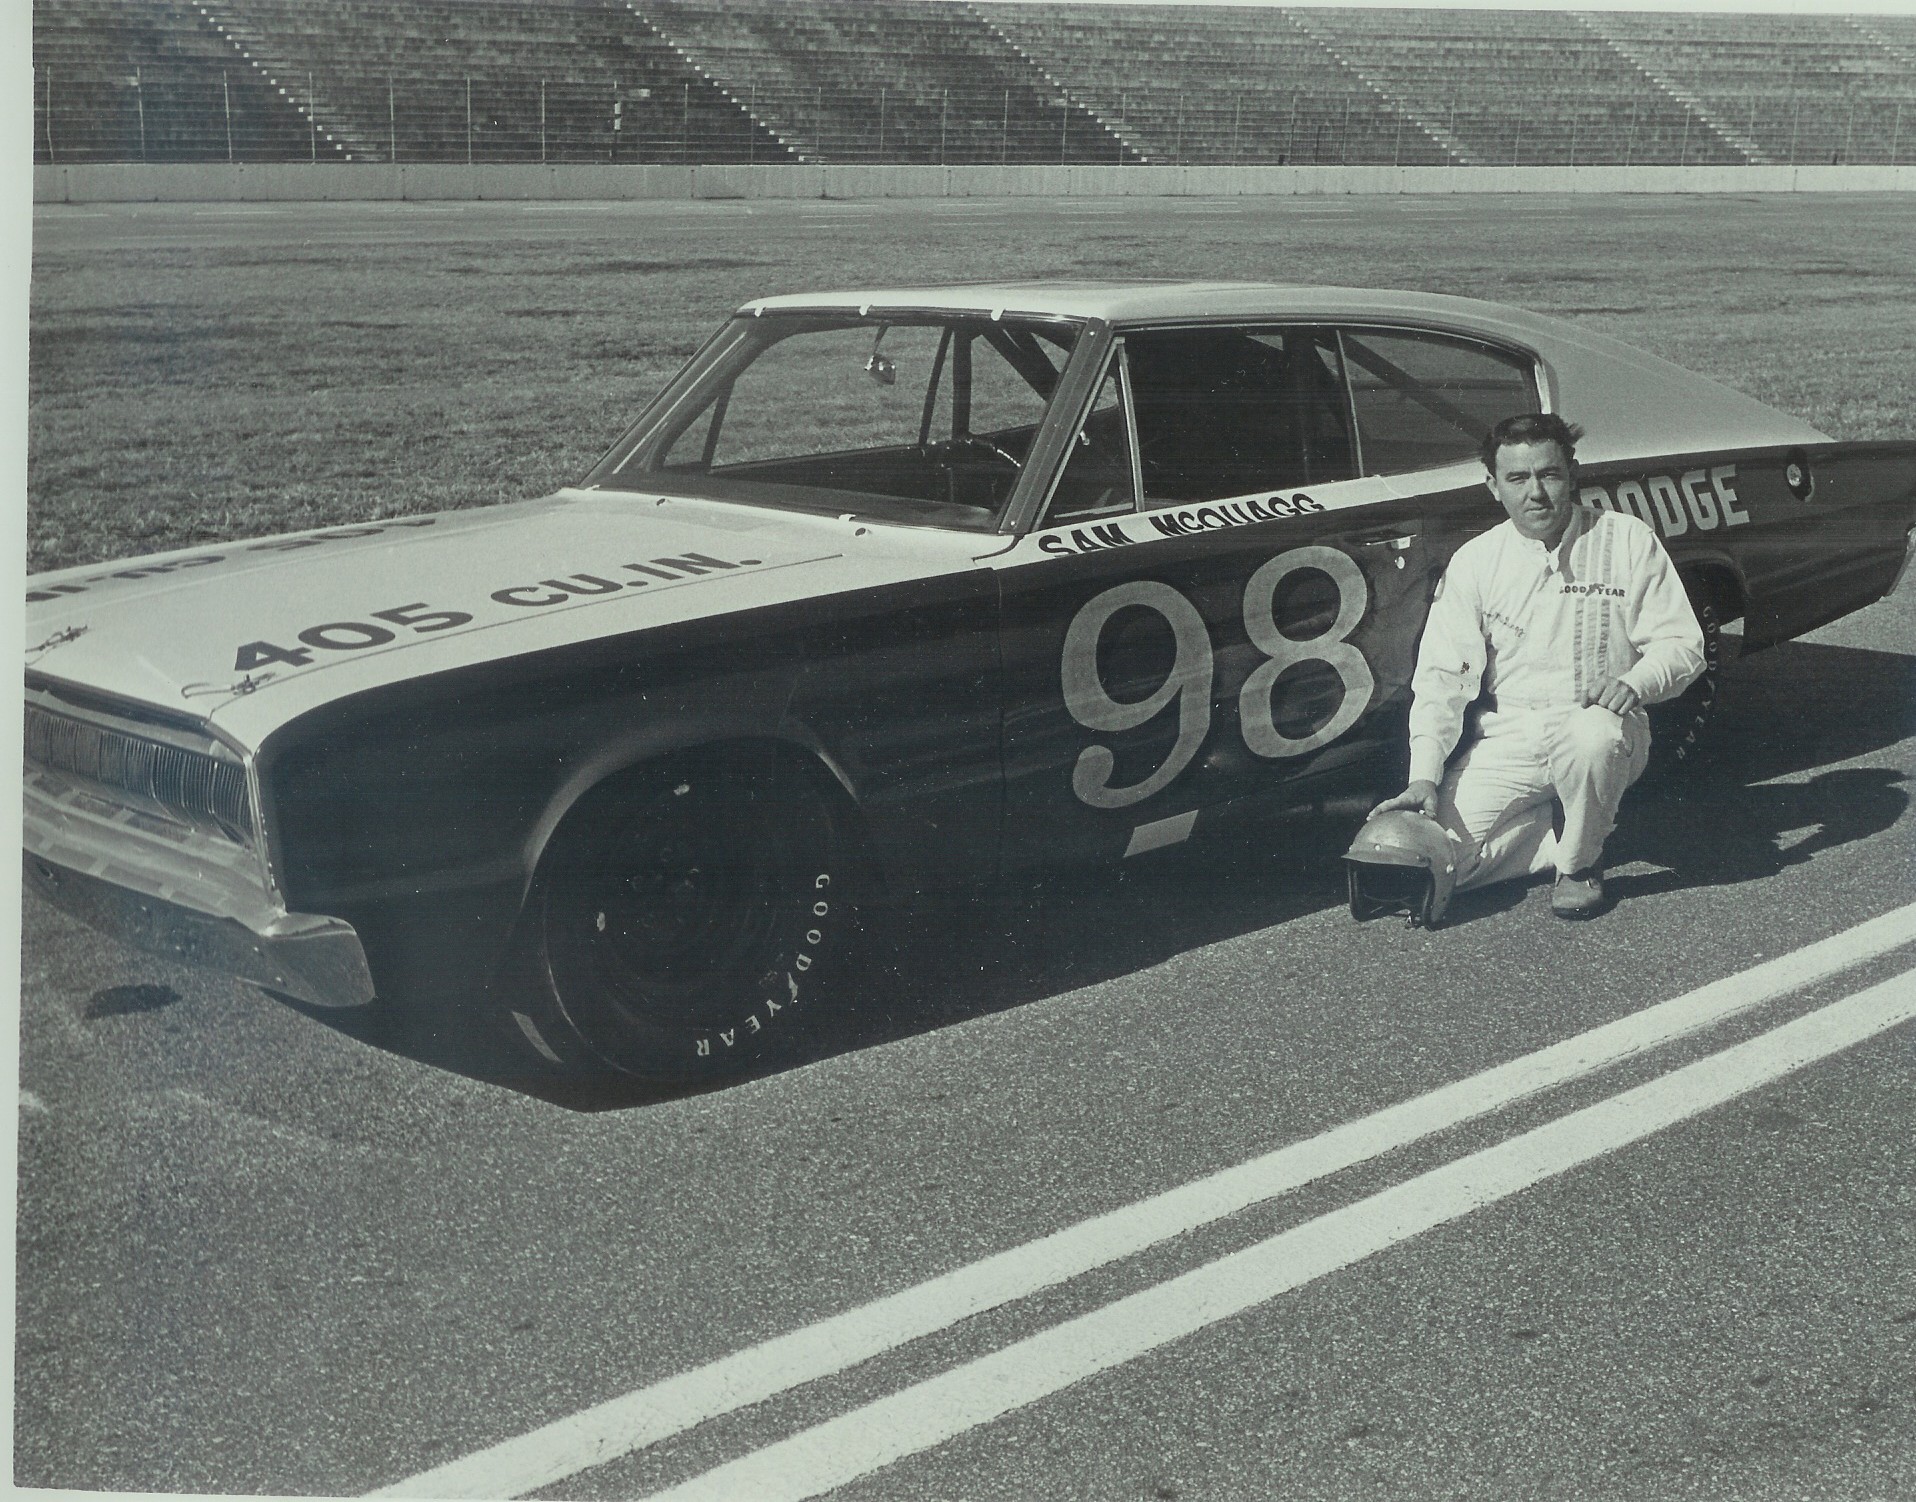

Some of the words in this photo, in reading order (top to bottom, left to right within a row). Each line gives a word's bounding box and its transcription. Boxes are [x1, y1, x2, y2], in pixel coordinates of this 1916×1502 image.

[1038, 522, 1136, 558] SAM
[234, 602, 474, 672] 405
[1060, 545, 1376, 809] 98
[695, 873, 831, 1056] GOODYEAR
